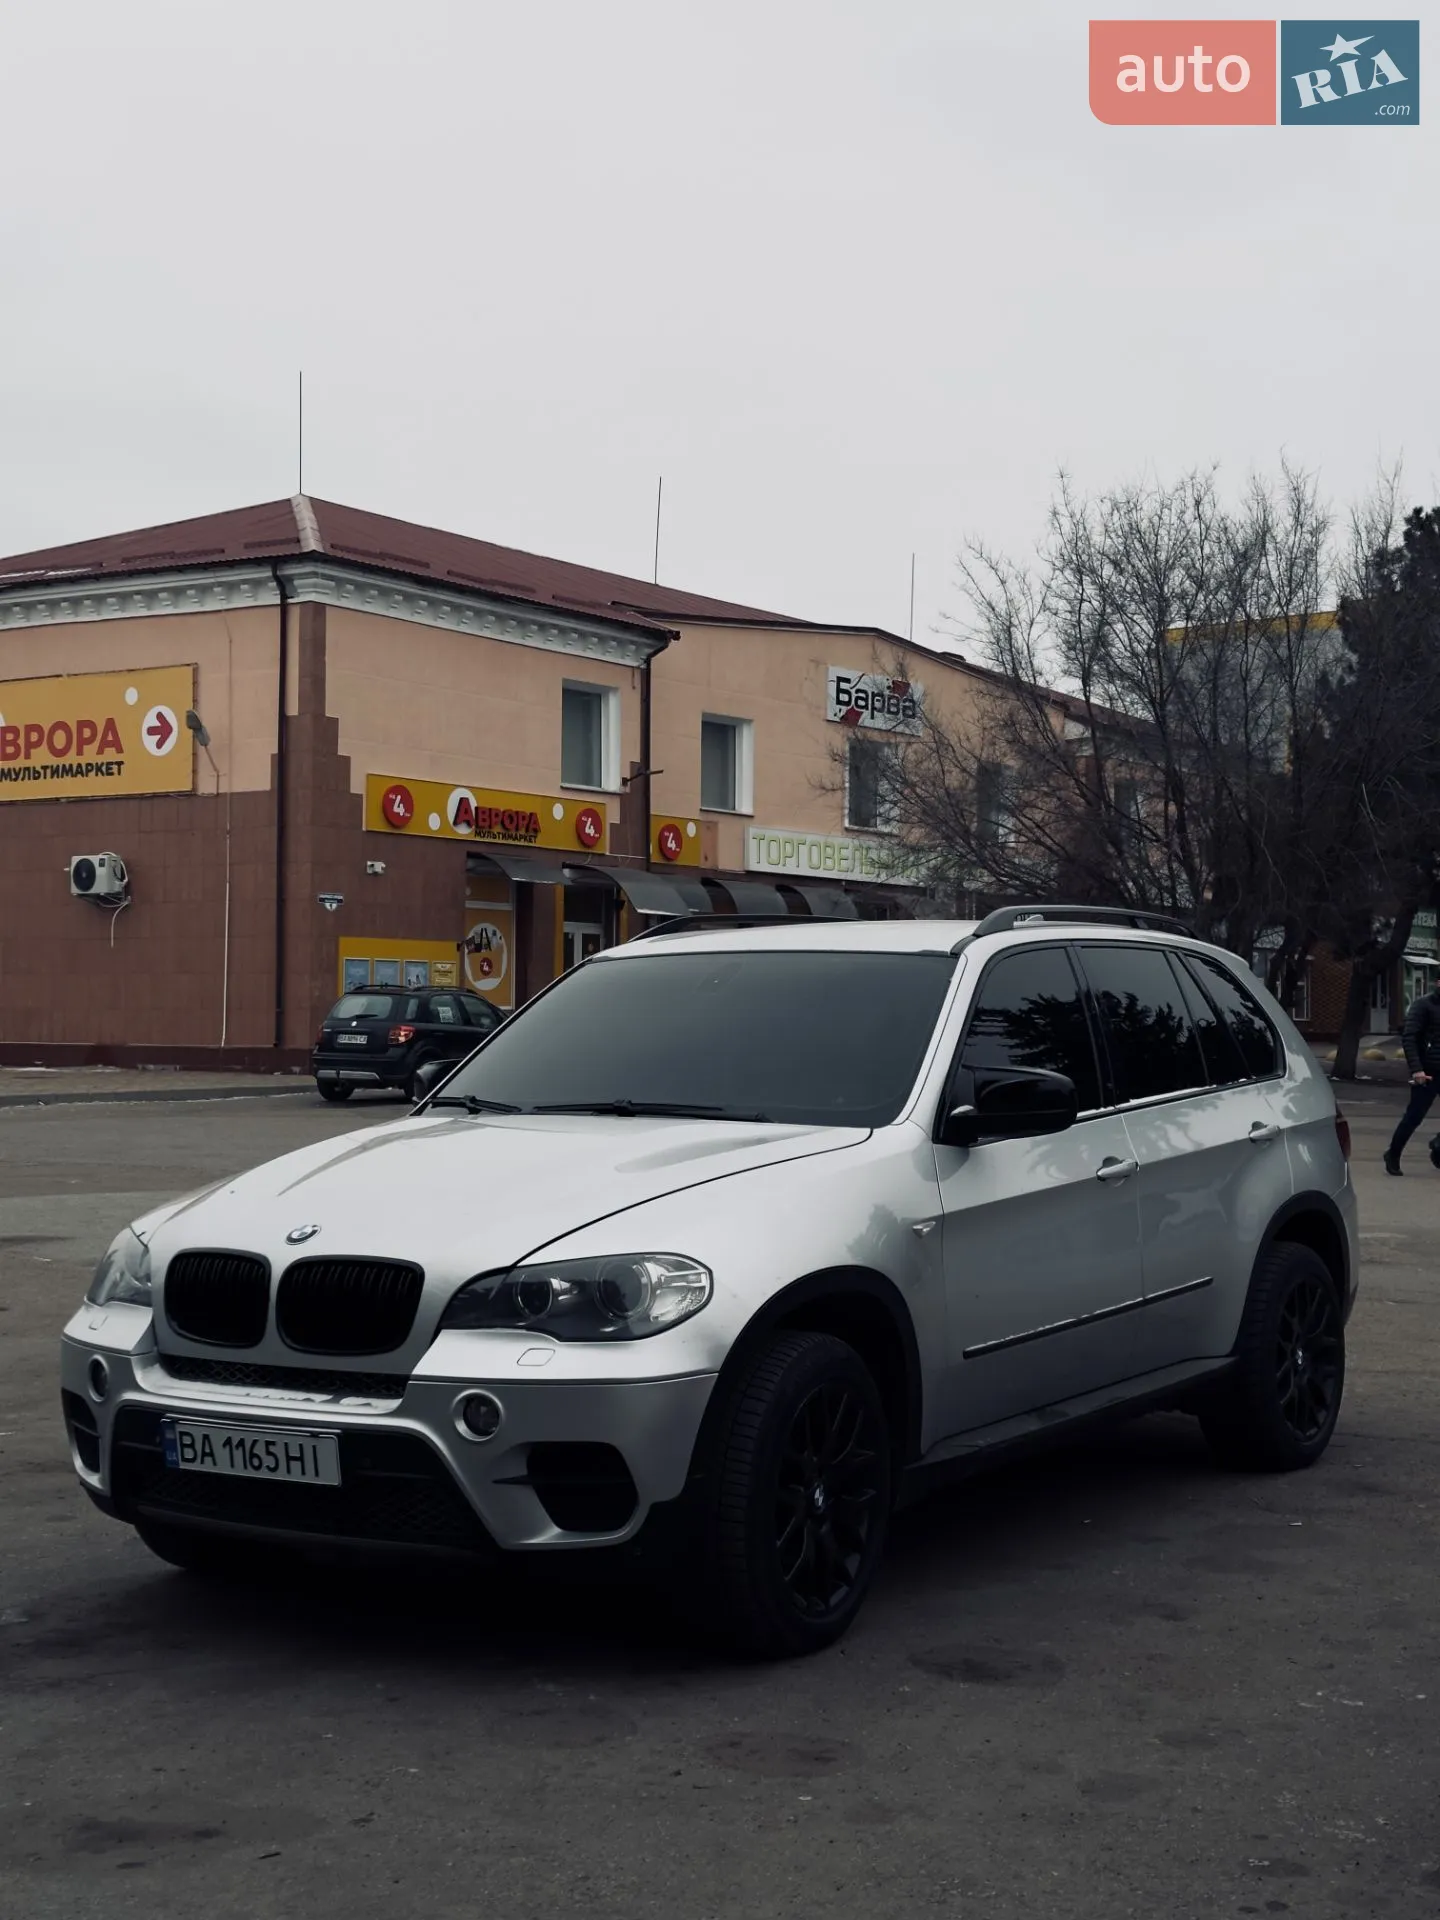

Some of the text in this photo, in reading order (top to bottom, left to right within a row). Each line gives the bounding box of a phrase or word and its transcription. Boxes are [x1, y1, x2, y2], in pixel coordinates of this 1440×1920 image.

[835, 675, 916, 720] Барва
[0, 761, 125, 783] МУЛЬТИМАРКЕТ
[393, 795, 405, 816] 4
[452, 796, 541, 833] АВРОРА
[474, 829, 538, 843] МУЛЬТИМАРКЕТ
[585, 817, 595, 837] 4
[667, 832, 676, 851] 4
[752, 833, 919, 878] ТОРГОВЕЛЬ
[179, 1431, 320, 1478] BA 1165 HI
